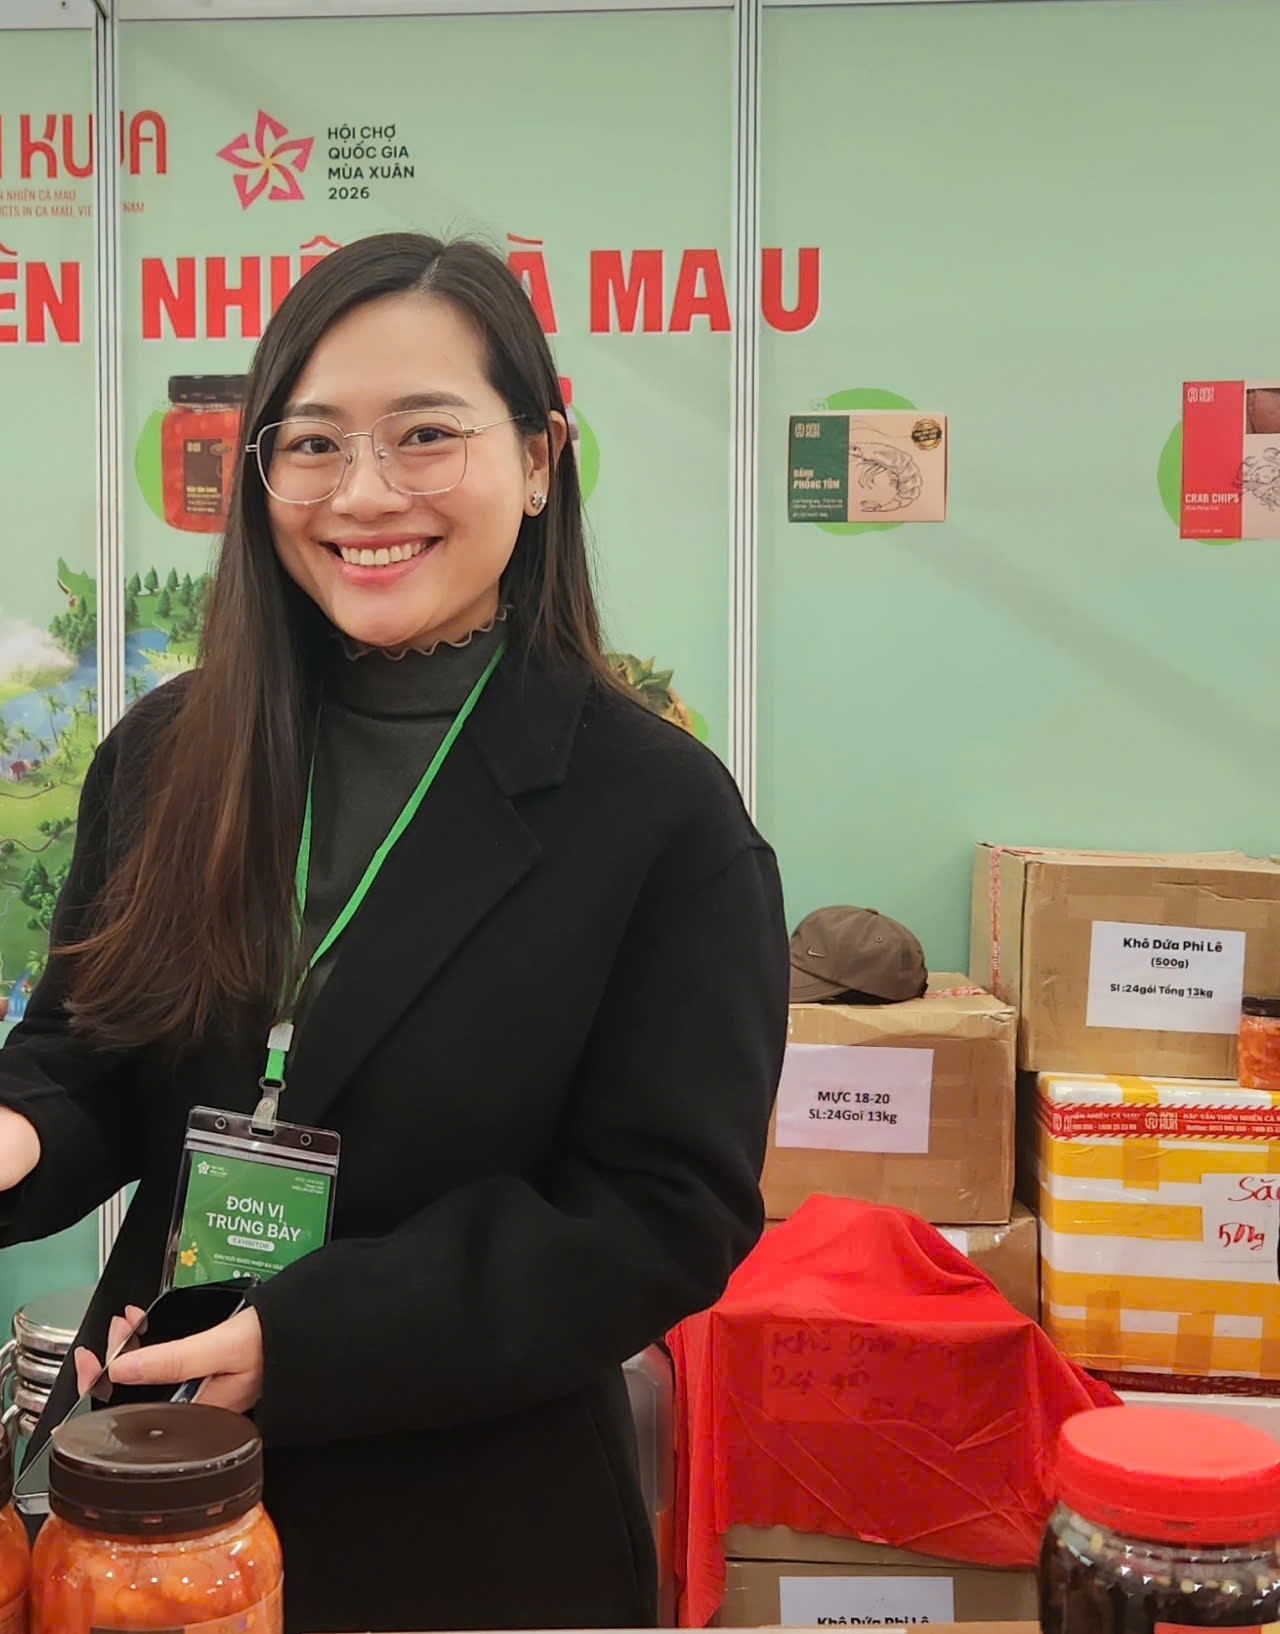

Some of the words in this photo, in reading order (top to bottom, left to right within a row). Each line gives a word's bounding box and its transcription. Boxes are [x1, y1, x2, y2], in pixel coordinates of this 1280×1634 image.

[328, 123, 356, 143] HỘI
[360, 124, 396, 142] CHỢ
[328, 140, 377, 160] QUỐC
[381, 146, 409, 159] GIA
[328, 163, 364, 180] MÙA
[369, 163, 415, 179] XUÂN
[328, 186, 370, 200] 2026
[590, 247, 821, 334] MAU
[1184, 493, 1209, 504] CRAB
[1211, 493, 1239, 504] CHIPS
[1123, 937, 1150, 949] Khô
[1153, 938, 1179, 950] Dứa
[1183, 941, 1204, 952] Phi
[1207, 941, 1223, 953] Lê
[1151, 957, 1189, 969] (500g)
[1159, 984, 1185, 997] Tổng
[1187, 987, 1213, 999] 13kg
[817, 1091, 851, 1104] MỰC
[854, 1092, 890, 1104] 18-20
[808, 1108, 864, 1121] SL:24Goi
[868, 1111, 898, 1125] 13kg
[226, 1195, 265, 1216] ĐƠN
[267, 1202, 284, 1223] VỊ
[206, 1212, 265, 1235] TRƯNG
[267, 1221, 301, 1242] BÀY
